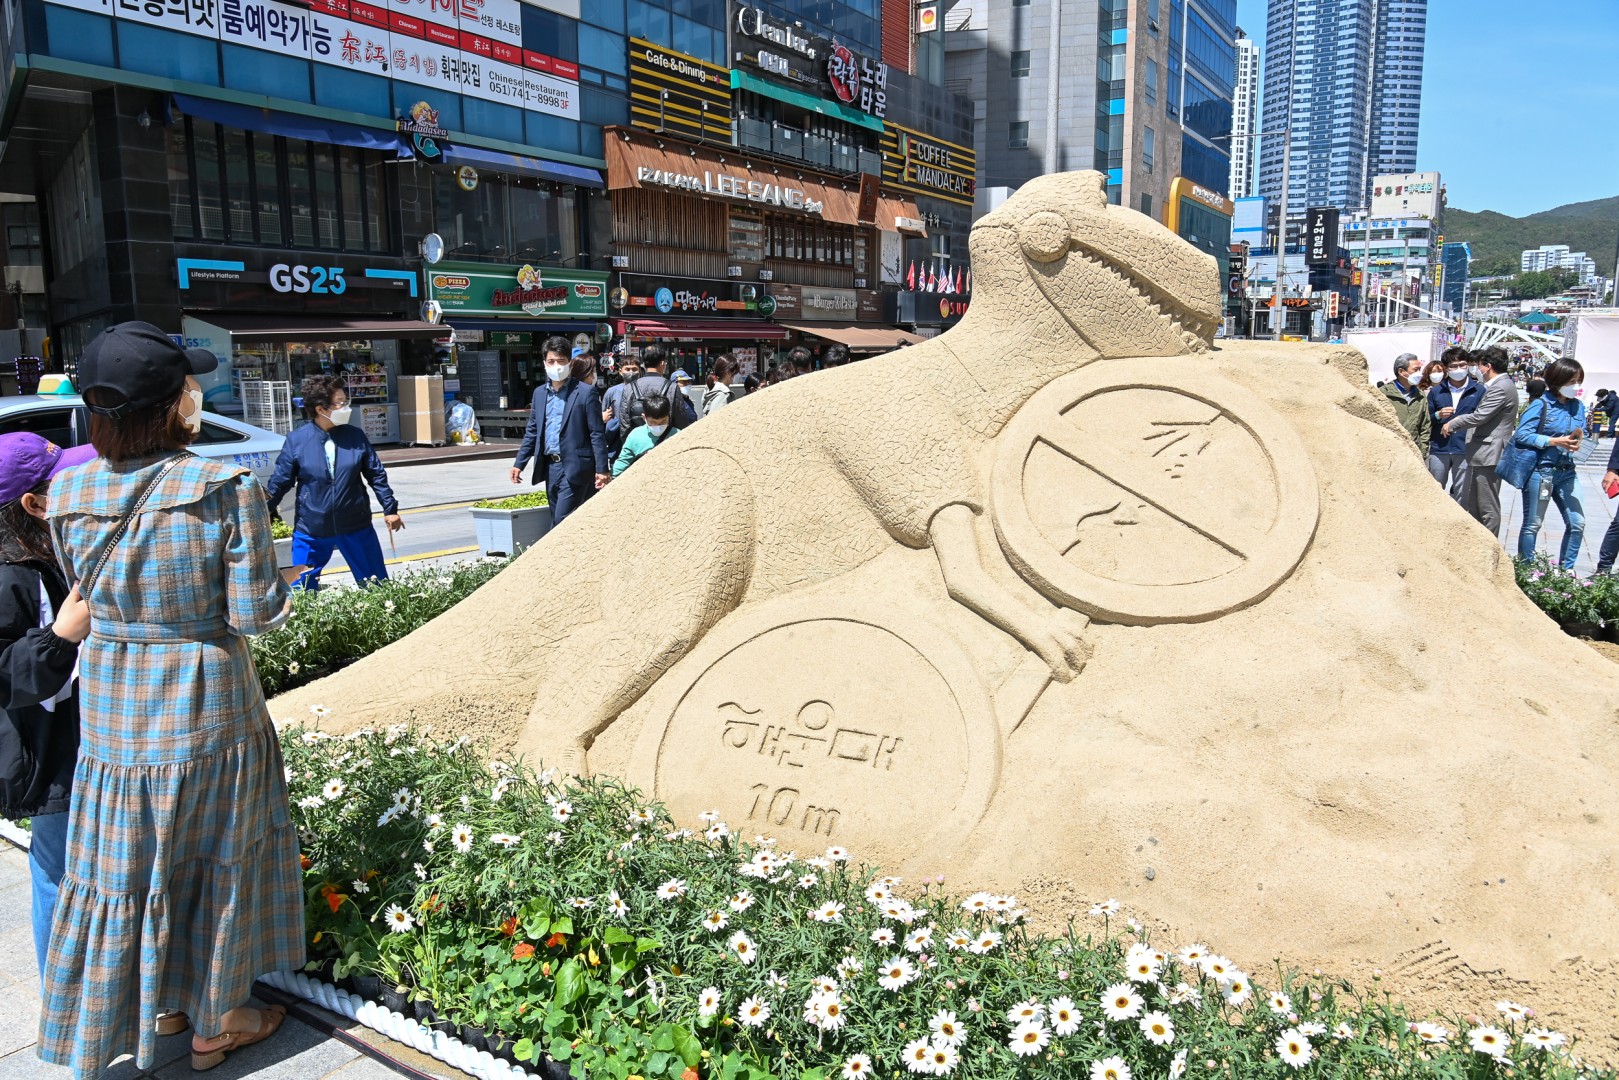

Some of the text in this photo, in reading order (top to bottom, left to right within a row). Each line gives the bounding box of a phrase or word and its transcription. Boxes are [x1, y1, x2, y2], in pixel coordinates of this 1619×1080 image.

[398, 20, 418, 31] Chinese
[495, 19, 521, 36] 레스토랑
[221, 0, 333, 56] 룸예약가능
[441, 54, 481, 88] 훠궈맛집
[488, 70, 569, 99] Chinese Restaurant
[860, 57, 888, 91] 노래
[560, 99, 570, 110] 3F
[860, 87, 887, 119] 타운
[917, 142, 951, 169] COFFEE
[637, 166, 702, 192] IZAKAYA
[916, 165, 967, 194] MANDALAY
[190, 271, 240, 280] Lifestyle Platform
[269, 263, 347, 295] GS25
[447, 278, 467, 286] PIZZA
[675, 290, 718, 311] 땅땅치킨
[186, 338, 212, 347] GS25
[239, 460, 269, 469] 737
[718, 699, 903, 771] 해운대
